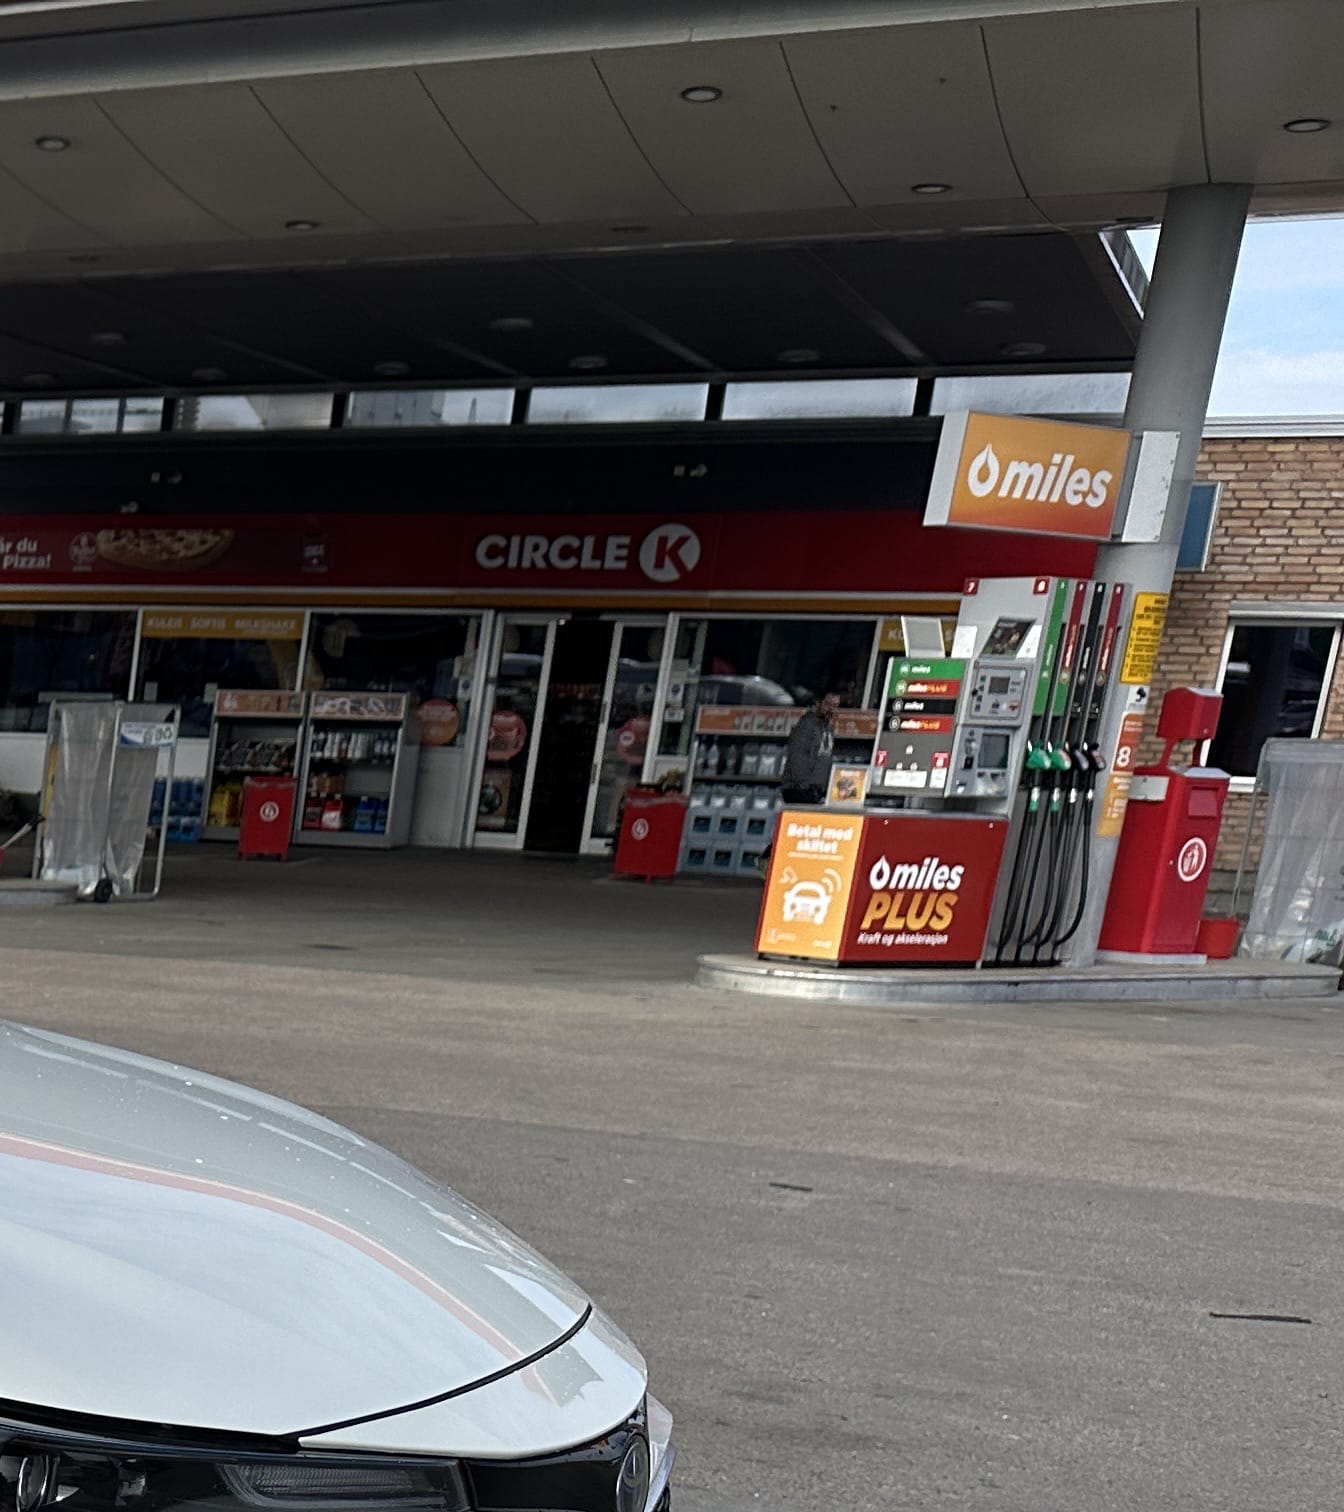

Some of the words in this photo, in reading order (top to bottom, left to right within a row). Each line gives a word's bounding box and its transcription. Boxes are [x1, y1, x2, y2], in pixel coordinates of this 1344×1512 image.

[997, 453, 1112, 508] miles
[15, 537, 38, 552] du
[475, 534, 632, 570] CIRCLE
[2, 553, 52, 570] Pizza!
[1117, 746, 1131, 766] 8
[888, 857, 965, 890] miles
[860, 892, 959, 932] PLUS
